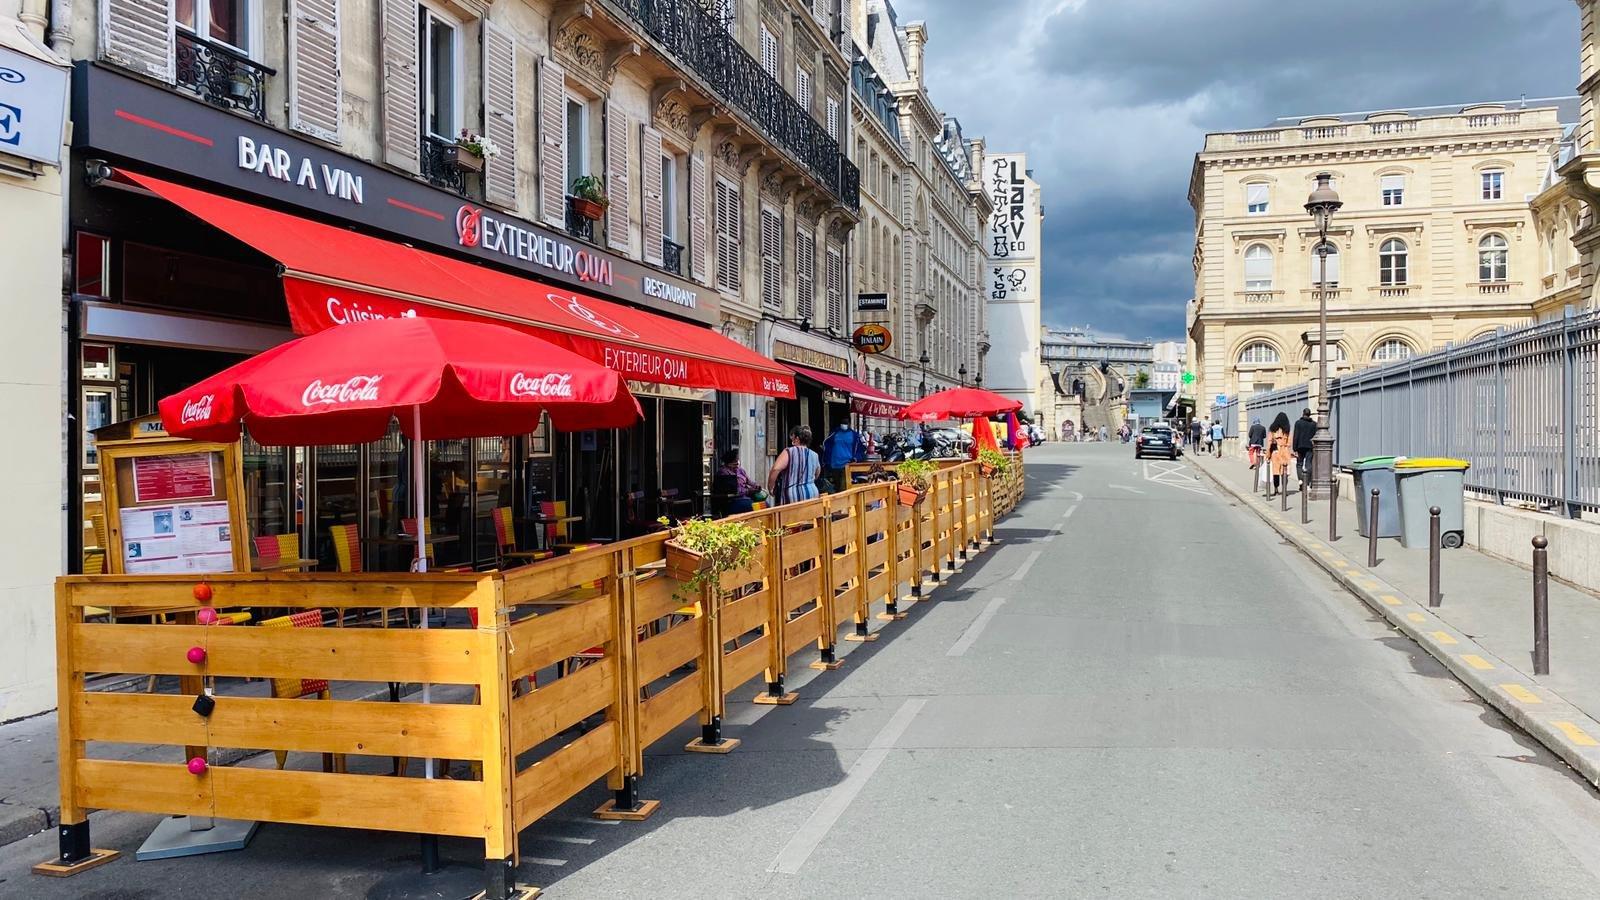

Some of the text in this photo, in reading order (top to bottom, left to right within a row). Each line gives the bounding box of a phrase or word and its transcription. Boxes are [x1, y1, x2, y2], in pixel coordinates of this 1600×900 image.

[239, 136, 363, 205] BAR A VIN
[482, 217, 613, 286] EXTERIEUR QUAI
[643, 277, 697, 308] RESTAURANT
[604, 347, 688, 380] EXTERIEUR QUAI
[302, 375, 382, 407] Coca-Cola
[510, 372, 573, 398] Coca-Cola
